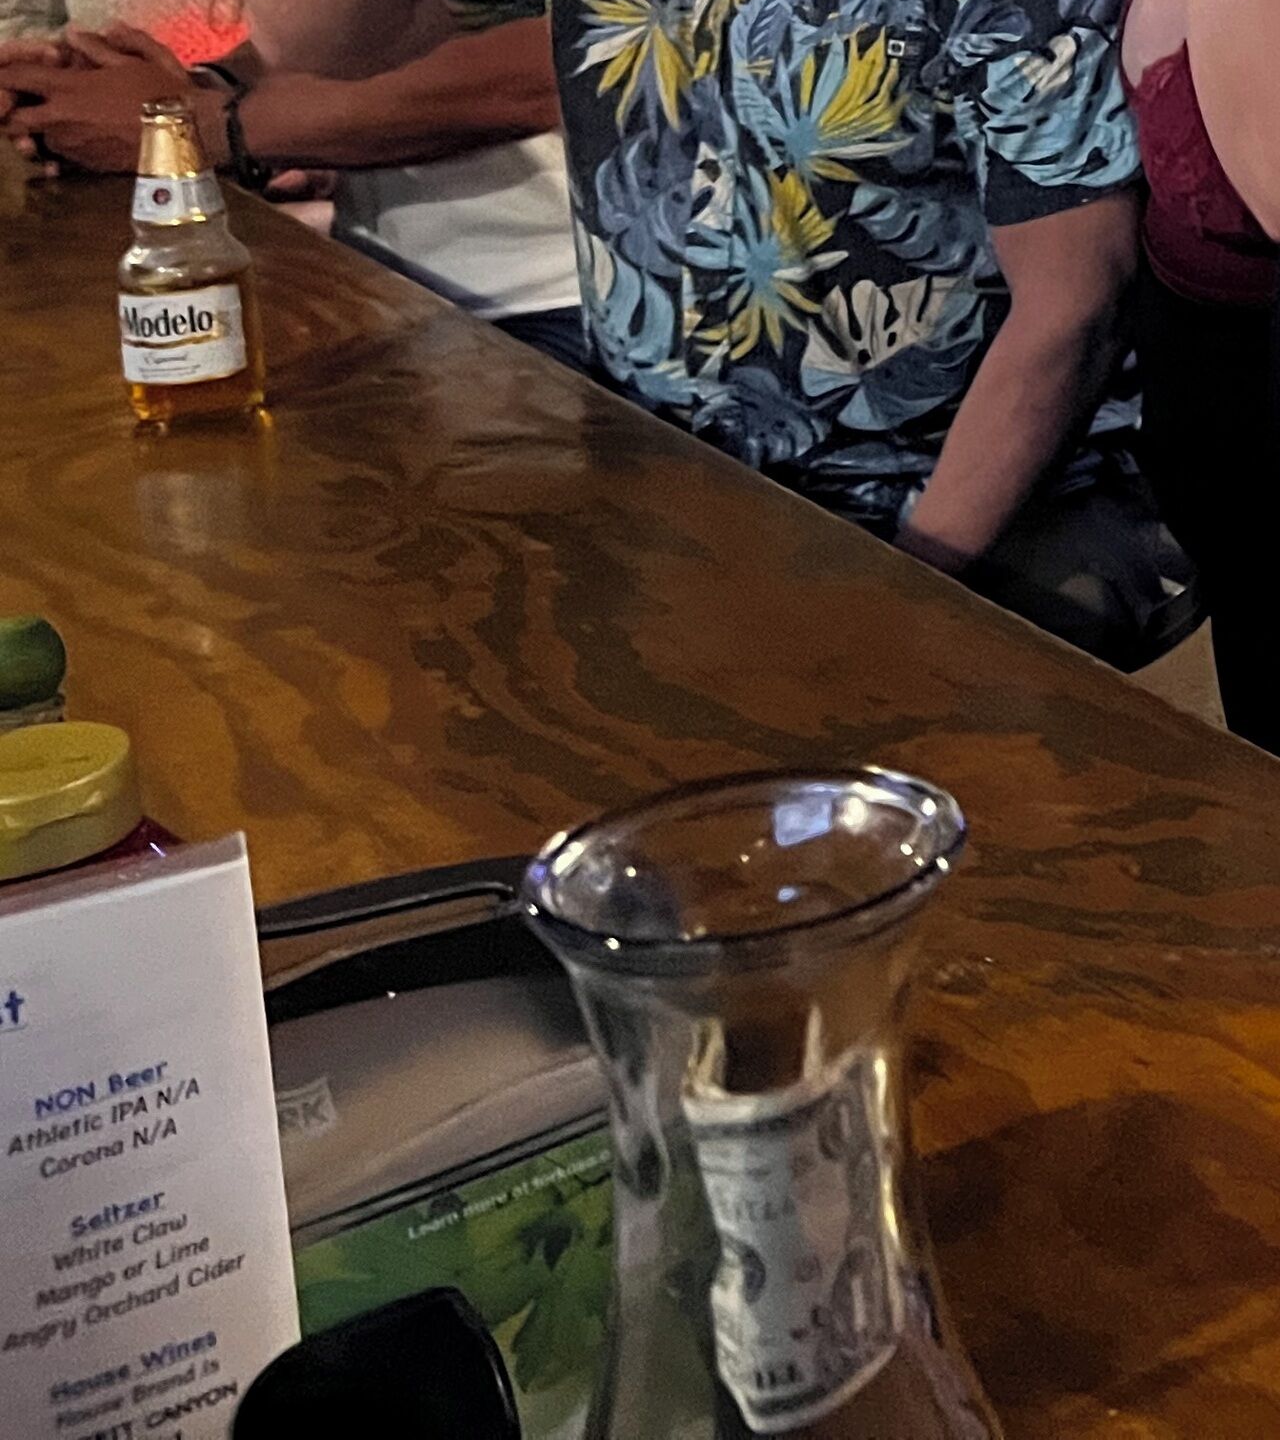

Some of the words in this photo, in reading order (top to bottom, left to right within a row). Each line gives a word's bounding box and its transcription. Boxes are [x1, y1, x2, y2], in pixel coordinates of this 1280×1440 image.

[7, 1113, 104, 1157] Athletic
[110, 1095, 149, 1125] IPA
[155, 1077, 201, 1109] N/A
[34, 1080, 97, 1119] NON
[107, 1060, 168, 1095] Beer
[39, 1139, 125, 1180] Corona
[131, 1117, 178, 1149] N/A
[53, 1237, 125, 1272] White
[132, 1213, 188, 1246] Claw
[69, 1190, 166, 1238] Seltzer
[35, 1270, 117, 1309] Mango
[121, 1259, 147, 1281] or
[153, 1236, 210, 1270] Lime
[2, 1317, 77, 1353] Angry
[84, 1273, 181, 1326] Orchard
[186, 1252, 247, 1289] Cider
[139, 1330, 218, 1369] Wines
[131, 1362, 196, 1404] Brand
[144, 1380, 239, 1430] CANYON
